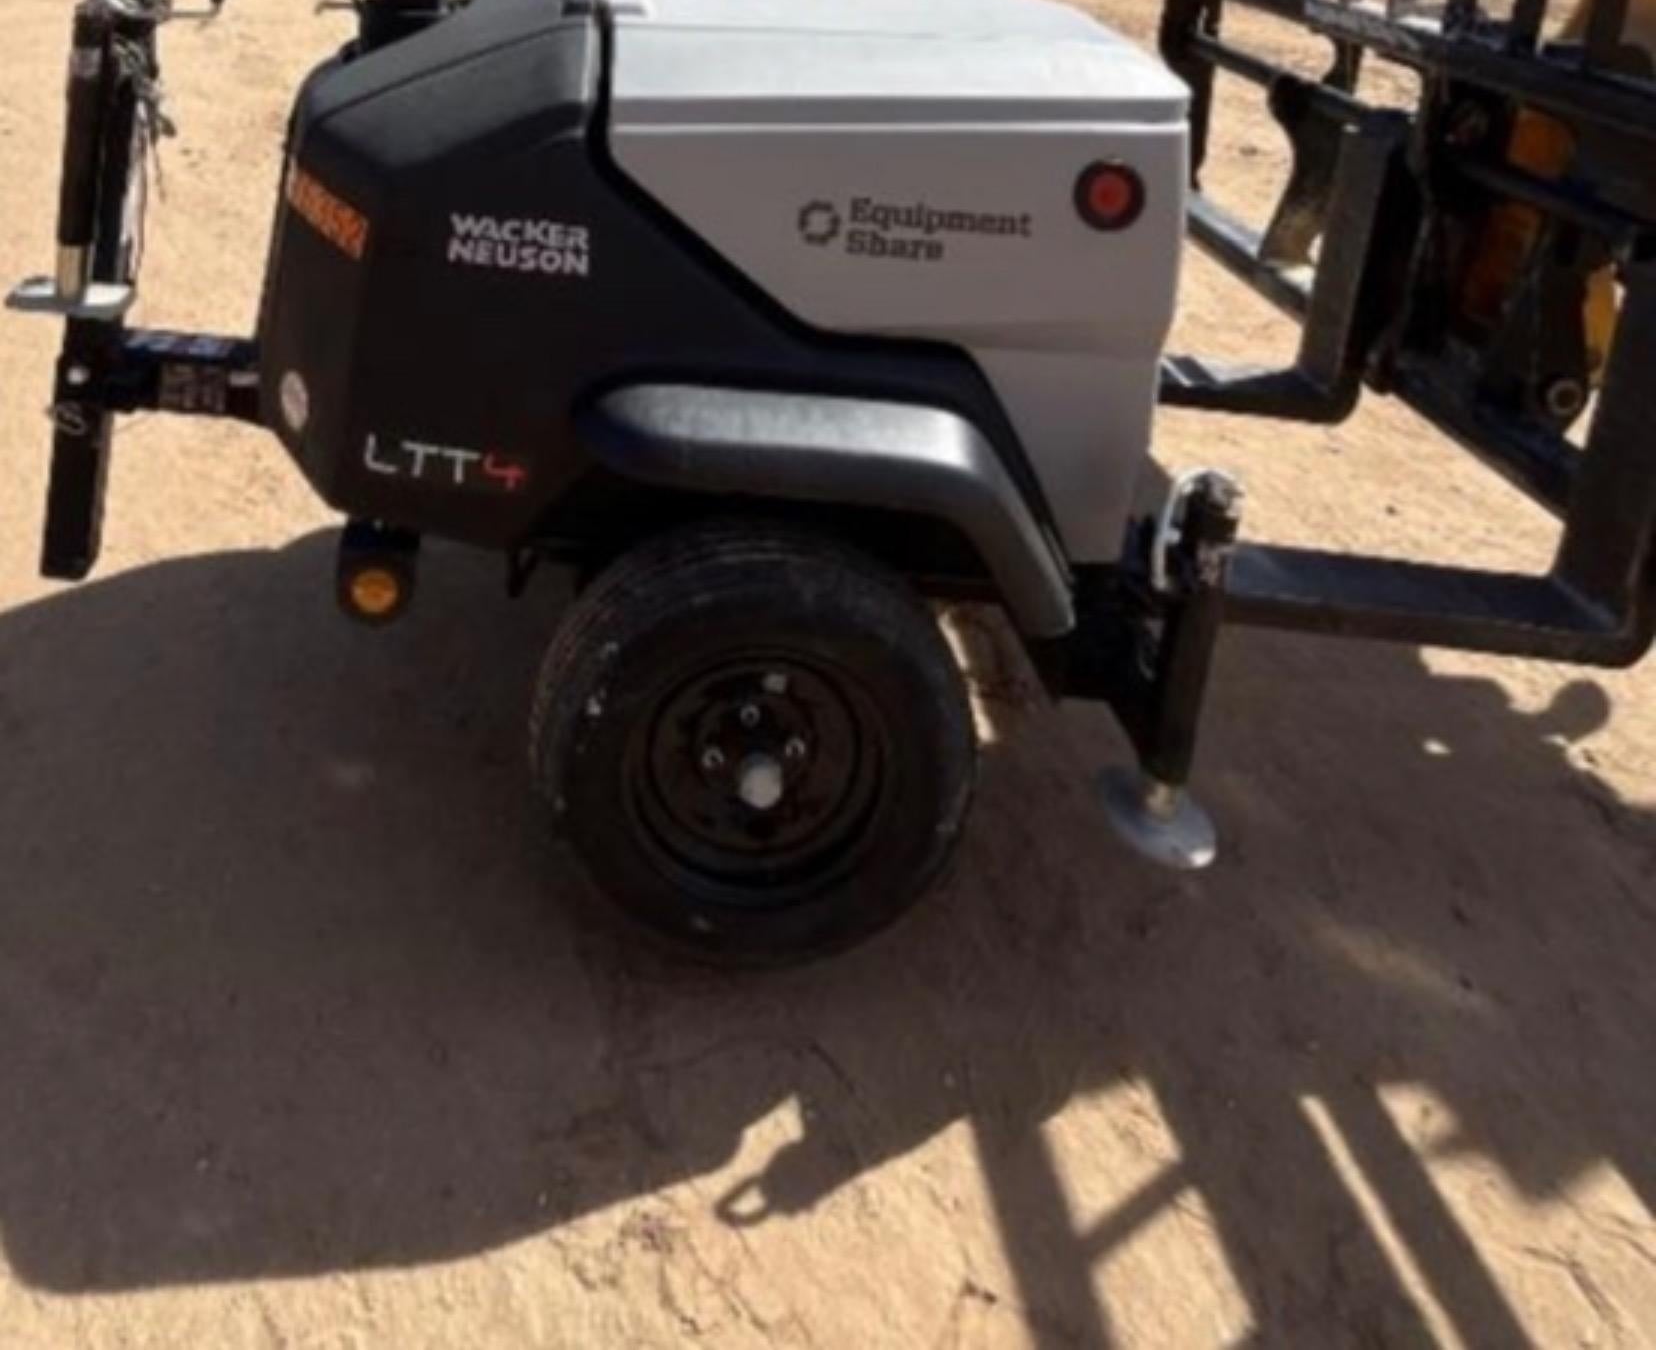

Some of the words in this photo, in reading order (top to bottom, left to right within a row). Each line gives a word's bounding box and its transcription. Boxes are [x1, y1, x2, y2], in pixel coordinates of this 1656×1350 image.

[450, 213, 589, 250] WACKER
[850, 197, 1033, 238] Equipment
[447, 239, 589, 276] NEUSON
[846, 230, 944, 261] Share
[364, 433, 525, 490] LTT4
